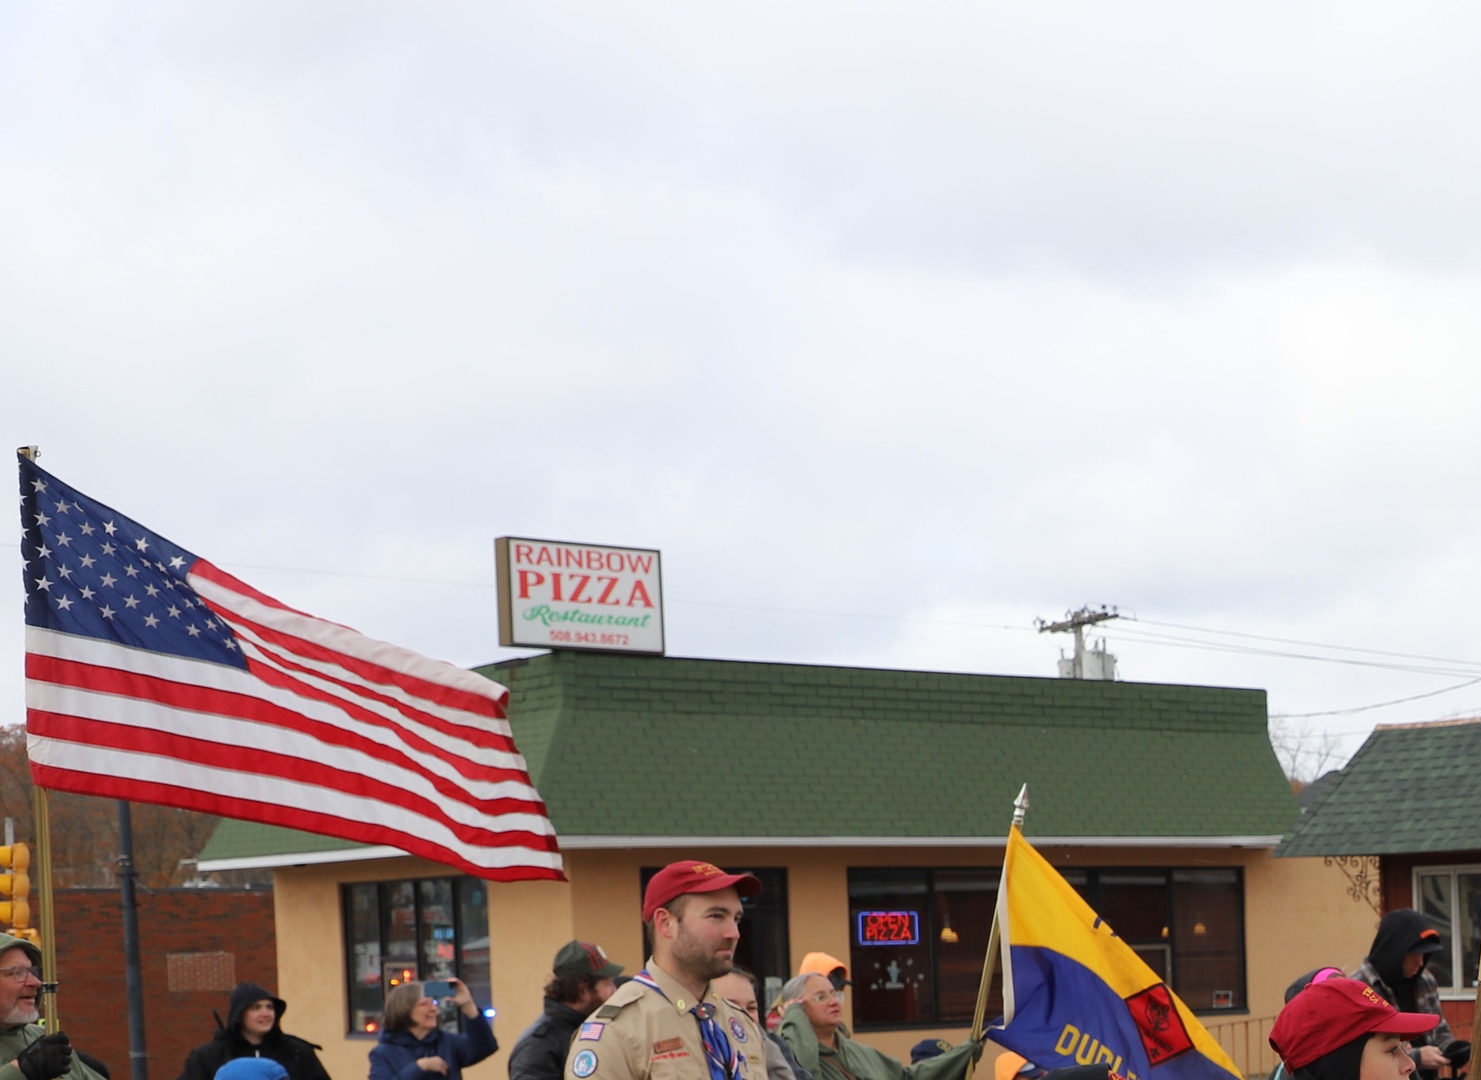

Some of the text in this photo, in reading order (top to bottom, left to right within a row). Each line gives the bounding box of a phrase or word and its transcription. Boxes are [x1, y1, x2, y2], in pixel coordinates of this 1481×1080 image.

[515, 543, 653, 574] RAINBOW
[517, 569, 655, 609] PIZZA
[522, 604, 650, 628] Restaurant
[866, 912, 909, 927] OPEN
[866, 926, 912, 941] PIZZA
